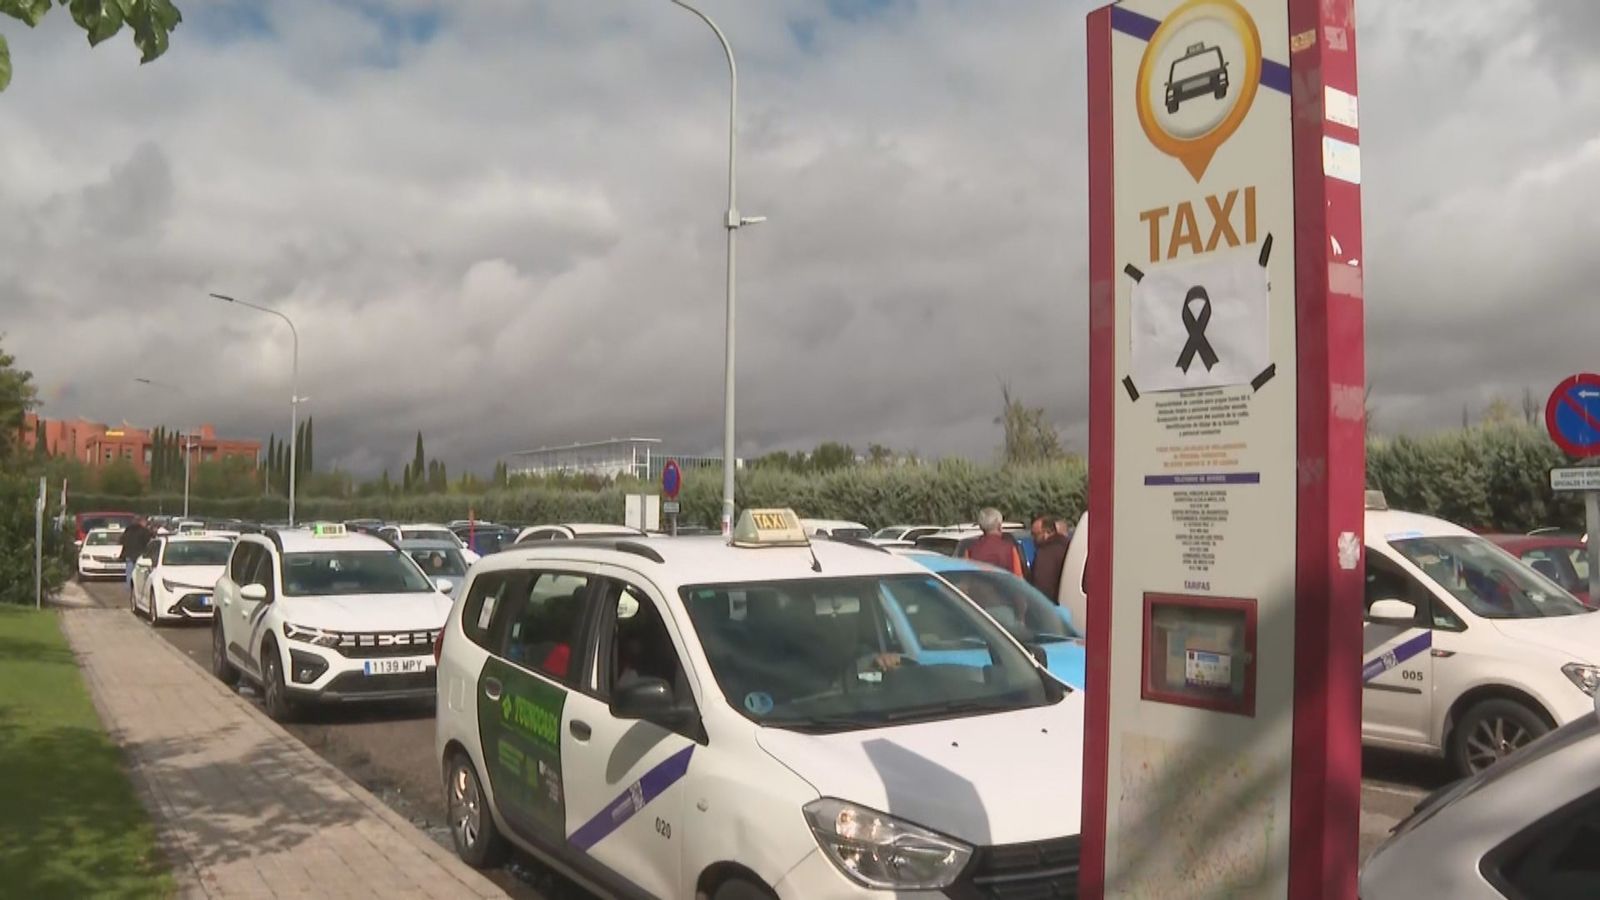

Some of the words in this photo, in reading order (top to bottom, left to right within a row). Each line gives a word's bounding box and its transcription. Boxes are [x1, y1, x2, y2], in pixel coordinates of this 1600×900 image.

[1139, 186, 1257, 263] TAXI
[752, 514, 786, 529] TAXI
[1184, 580, 1210, 591] TARIFAS
[373, 660, 399, 673] 1139
[402, 659, 422, 671] MPY
[1402, 670, 1423, 681] 005
[655, 816, 671, 839] 020
